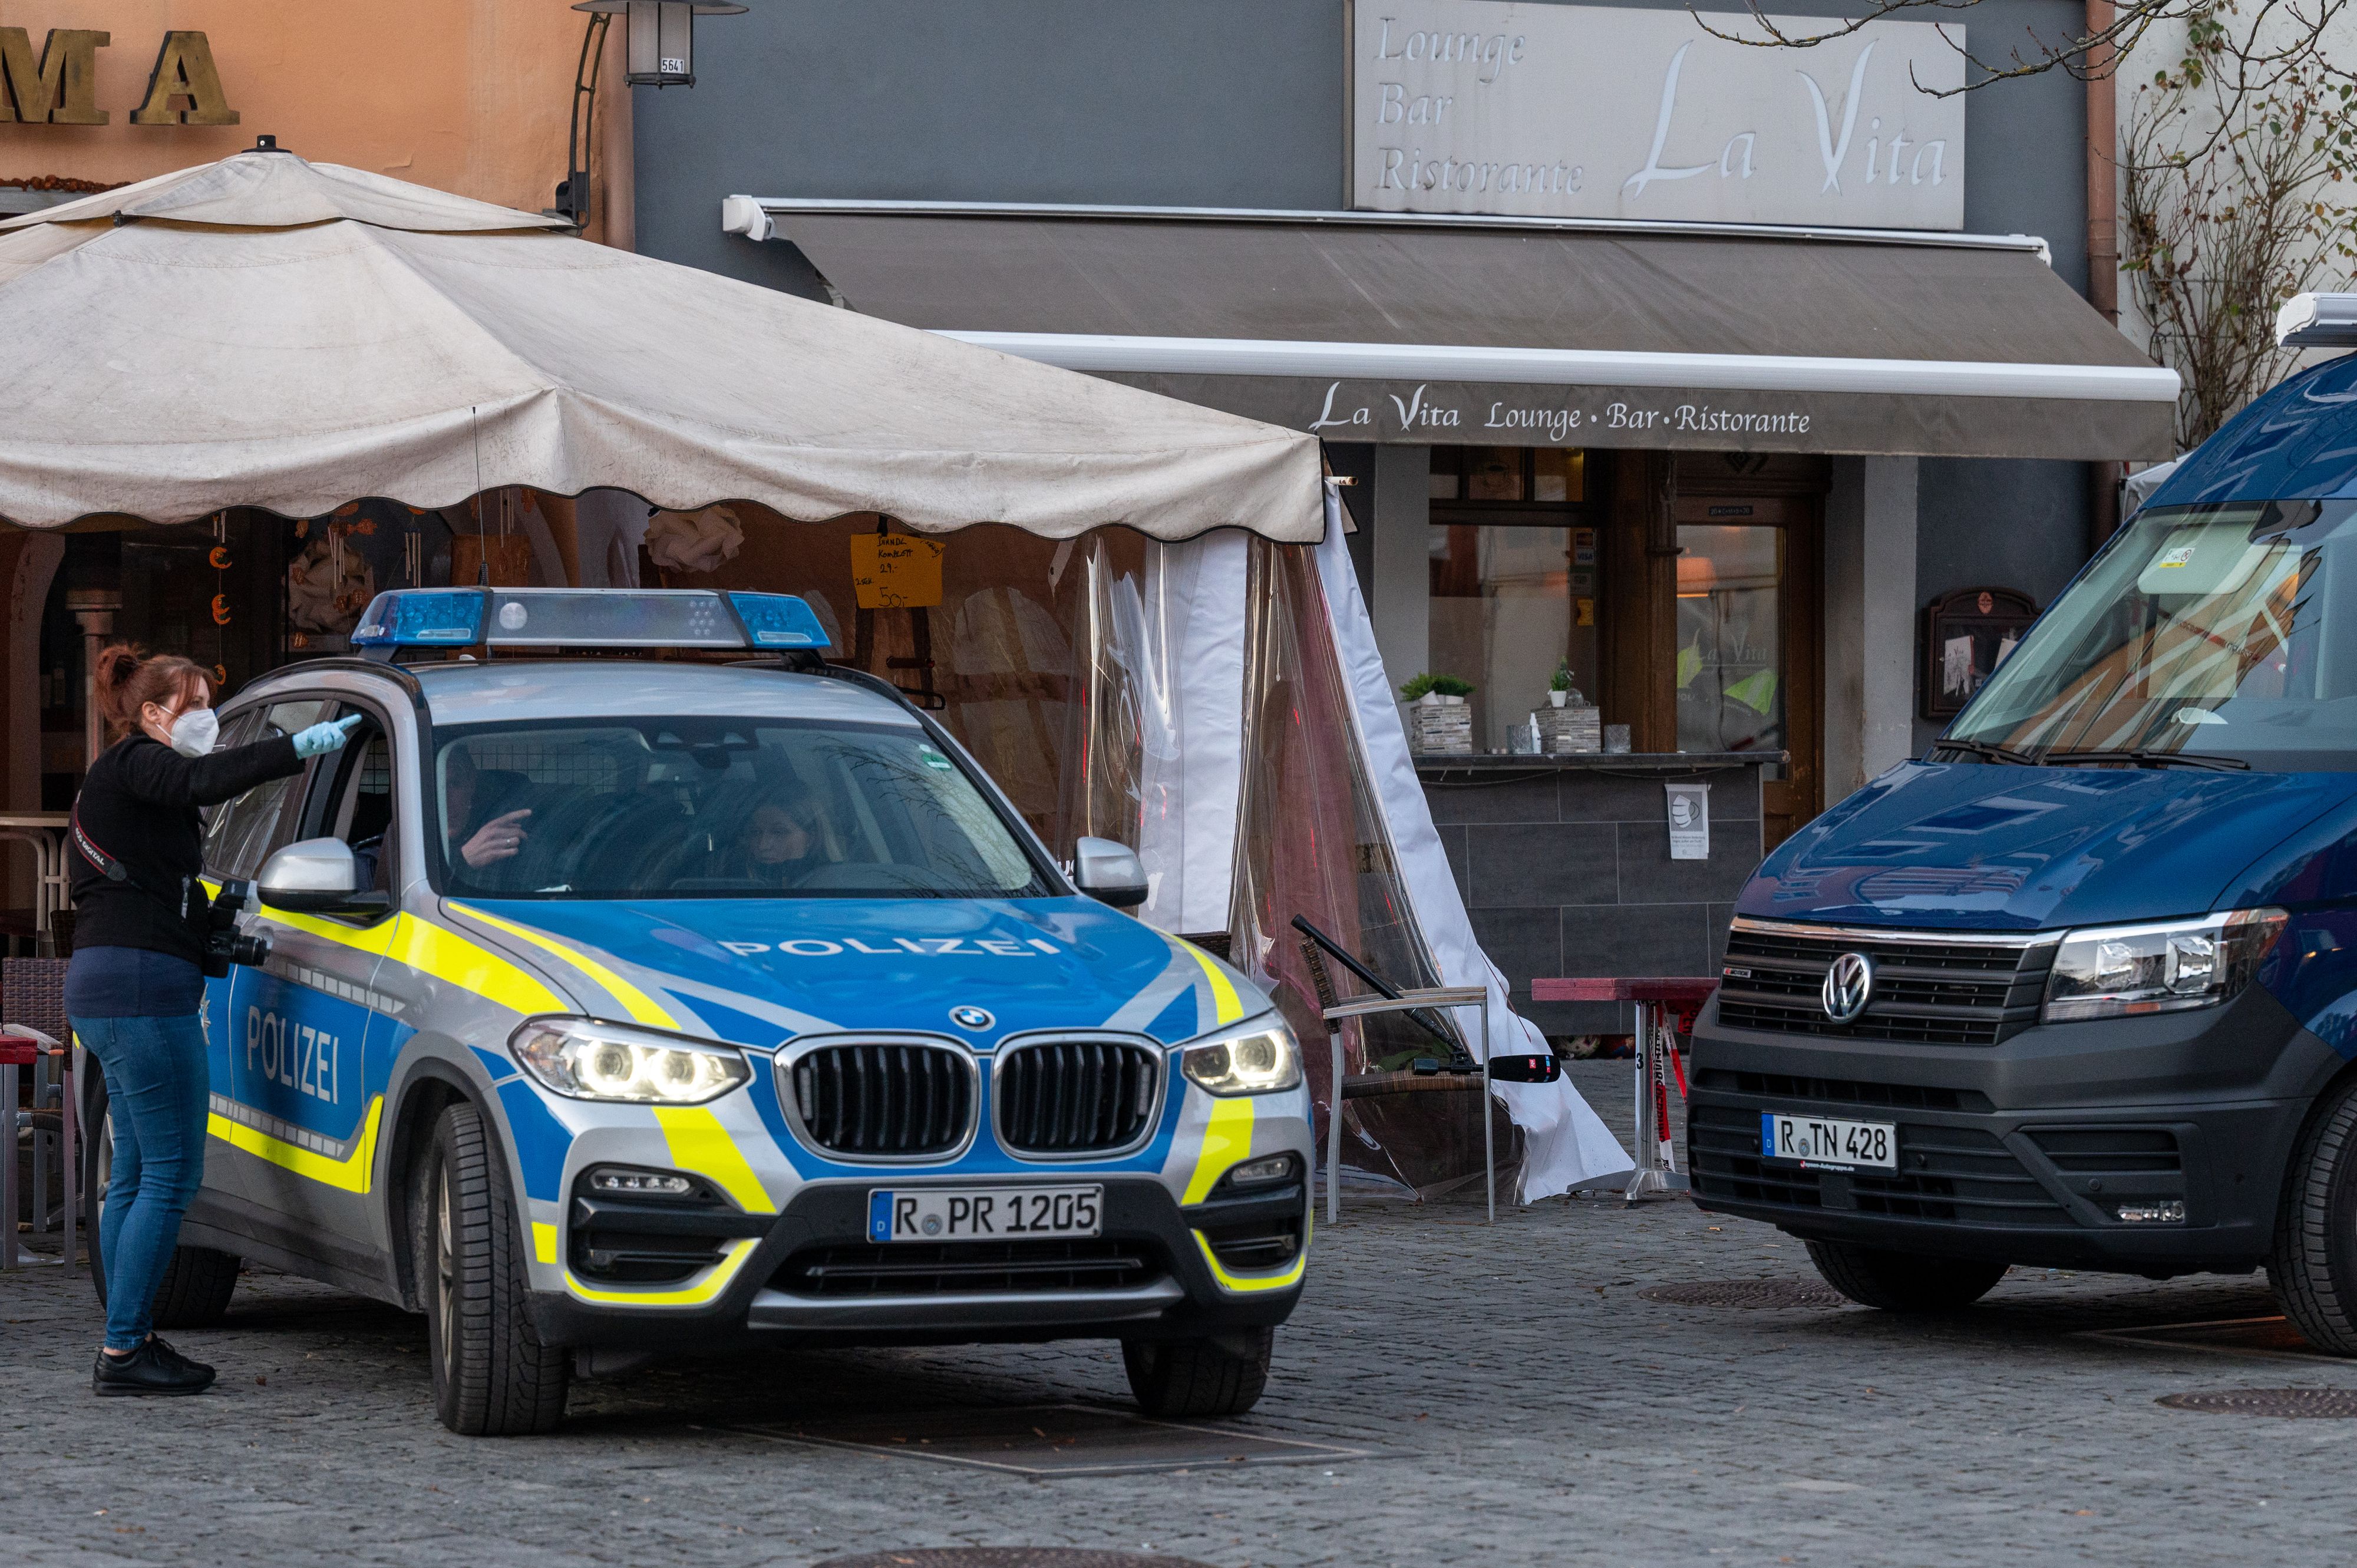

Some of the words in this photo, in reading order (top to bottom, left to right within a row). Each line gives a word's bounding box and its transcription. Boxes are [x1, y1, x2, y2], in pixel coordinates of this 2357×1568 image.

[662, 60, 683, 72] 5641
[1374, 17, 1525, 84] Lounge
[1375, 82, 1453, 125] Bar
[1620, 39, 1757, 200] La
[1795, 38, 1946, 196] Vita
[1374, 148, 1583, 194] Ristorante
[1308, 381, 1371, 431] La
[1389, 384, 1461, 432] Vita
[1484, 402, 1581, 441] Lounge
[1607, 402, 1659, 428] Bar
[1675, 405, 1810, 433] Ristorante
[82, 841, 105, 866] DIGITAL
[717, 938, 1061, 956] POLIZEI
[247, 1005, 339, 1105] POLIZEI
[1636, 1053, 1644, 1069] 3
[1767, 1139, 1771, 1148] D
[1781, 1120, 1794, 1153] R
[1809, 1123, 1837, 1157] TN
[1846, 1126, 1887, 1161] 428
[876, 1220, 886, 1232] D
[895, 1197, 917, 1234] R
[948, 1196, 994, 1233] PR
[1006, 1193, 1097, 1233] 1205
